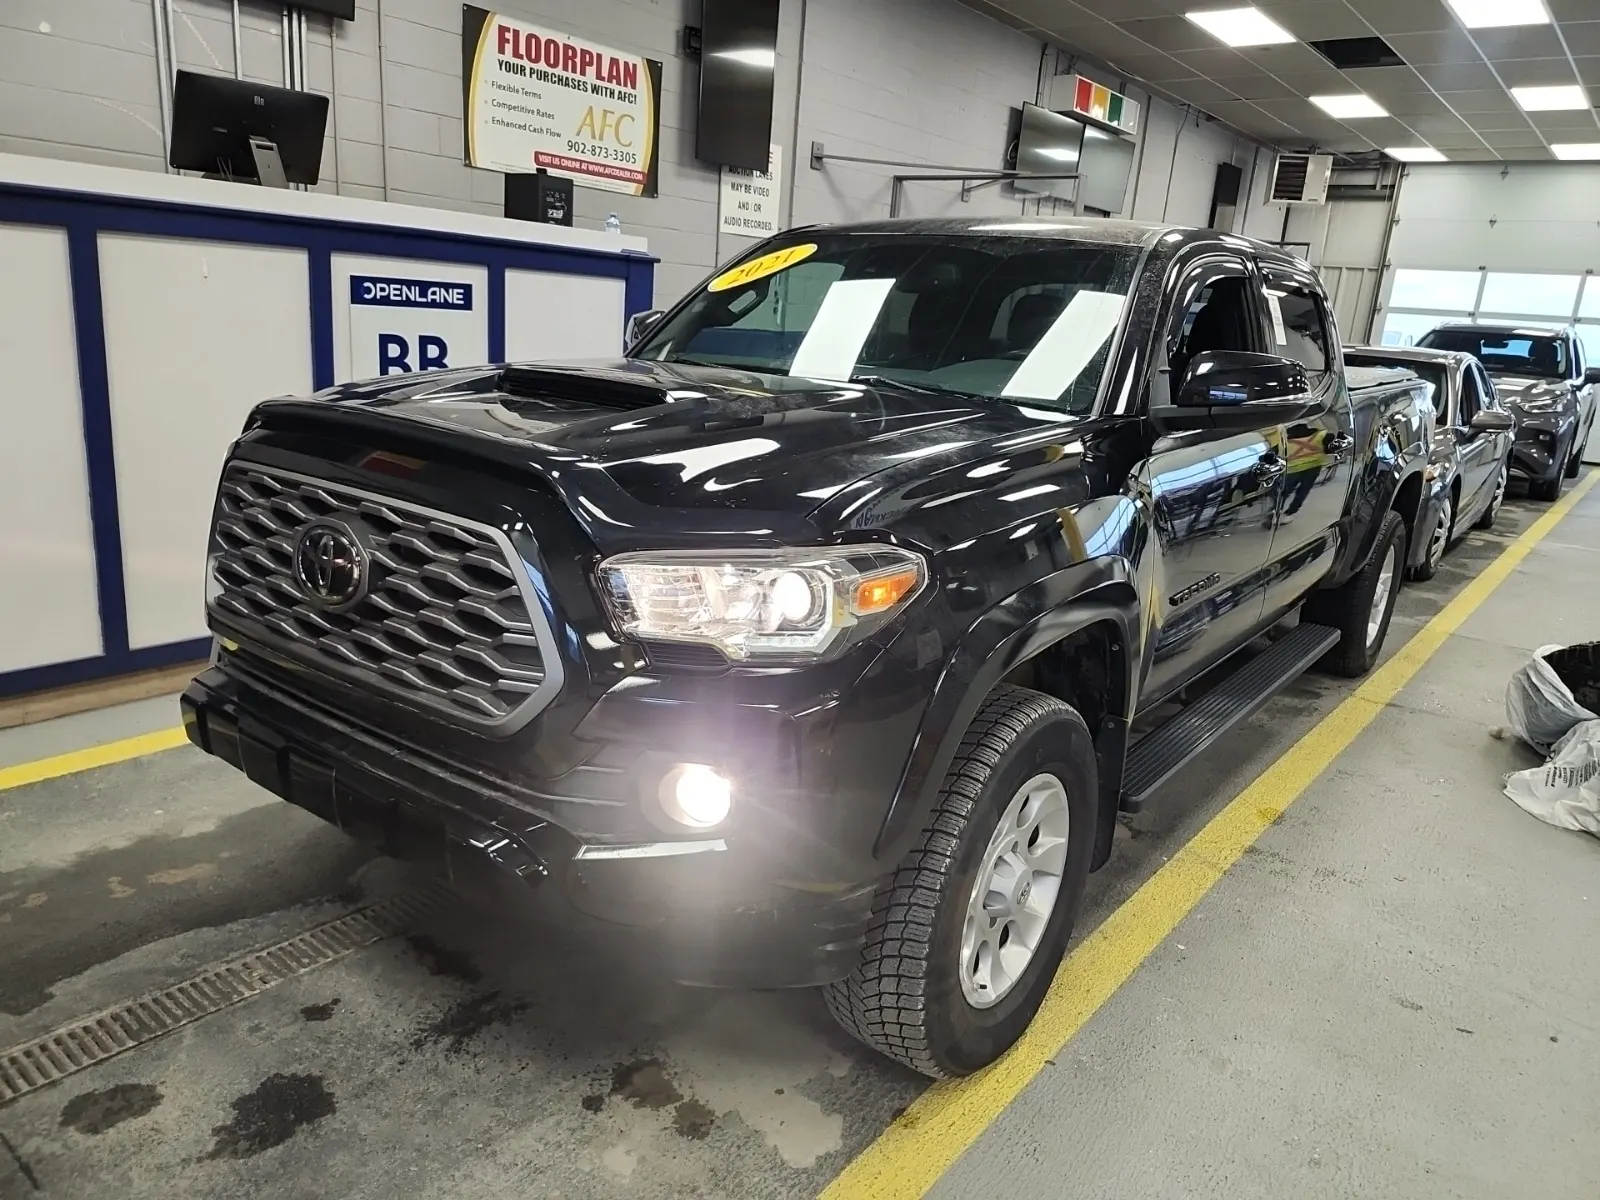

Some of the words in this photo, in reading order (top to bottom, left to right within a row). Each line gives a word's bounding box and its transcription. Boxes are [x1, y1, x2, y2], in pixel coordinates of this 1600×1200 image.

[498, 24, 637, 90] FLOORPLAN
[491, 81, 519, 94] Flexible
[521, 87, 542, 99] Terms
[497, 59, 526, 77] YOUR
[530, 67, 588, 92] PURCHASES
[591, 83, 615, 99] WITH
[617, 90, 637, 105] AFC!
[491, 99, 535, 115] Competitive
[536, 108, 555, 120] Rates
[491, 116, 527, 131] Enhanced
[528, 124, 544, 135] Cash
[545, 128, 562, 138] Flow
[576, 105, 635, 147] AFC
[567, 140, 636, 164] 902-873-3305
[538, 154, 551, 164] VISIT
[552, 157, 560, 165] US
[560, 158, 580, 169] ONLINE
[581, 162, 587, 170] AT
[588, 164, 643, 180] WWW.AFCDEALER.COM
[730, 181, 743, 193] MAY
[744, 184, 752, 195] BE
[753, 185, 770, 198] VIDEO
[737, 200, 750, 211] AND
[753, 203, 762, 213] OR
[723, 215, 742, 227] AUDIO
[726, 249, 796, 285] 2021
[361, 281, 464, 305] OPENLANE
